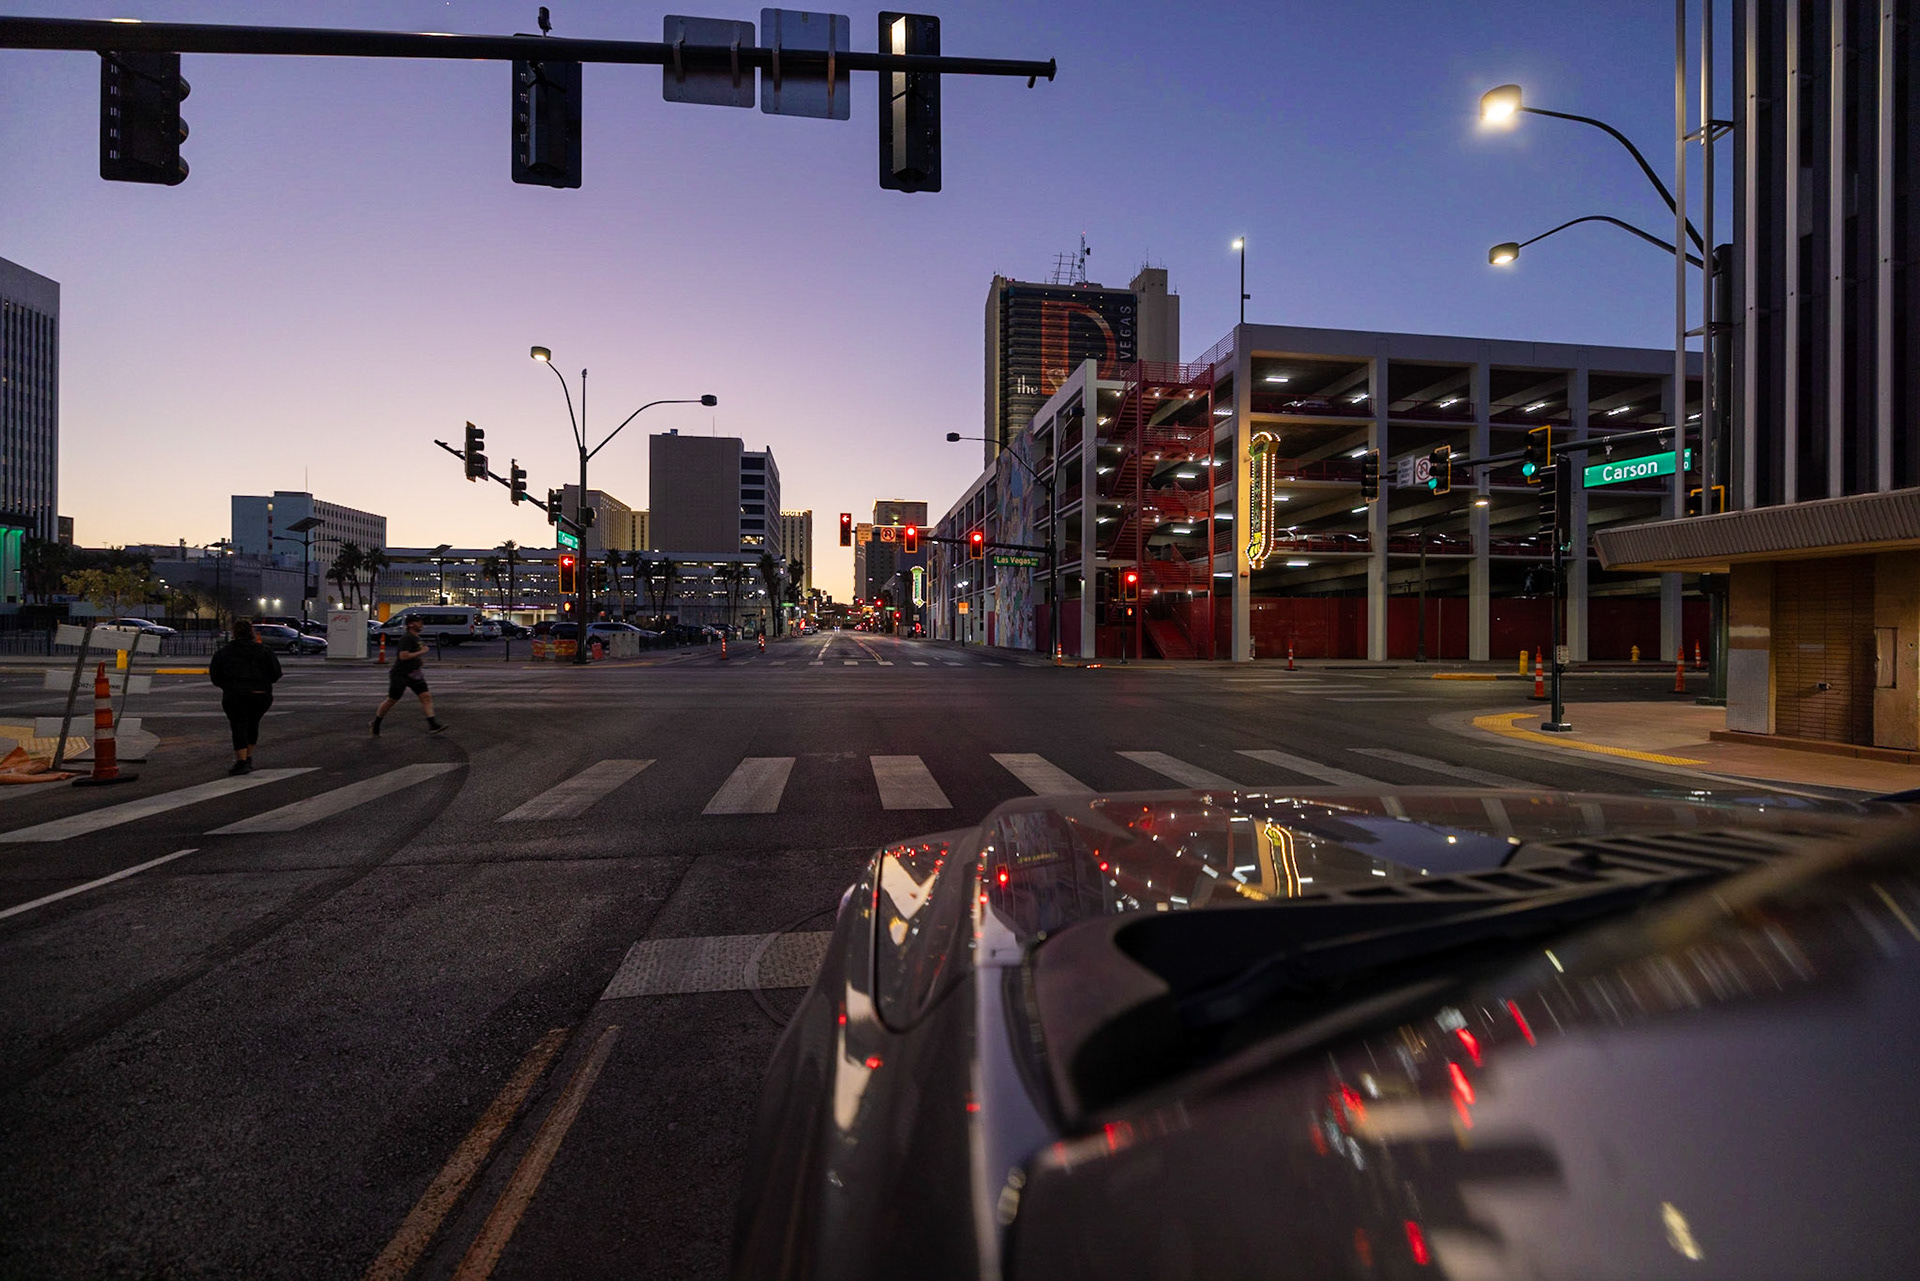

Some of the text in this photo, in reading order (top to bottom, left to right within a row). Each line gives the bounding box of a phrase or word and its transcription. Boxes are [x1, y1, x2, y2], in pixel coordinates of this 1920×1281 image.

[1120, 305, 1131, 359] VEGAS
[1017, 375, 1038, 395] the
[1602, 461, 1658, 482] Carson
[996, 556, 1008, 564] Las
[1010, 557, 1031, 566] Vegas
